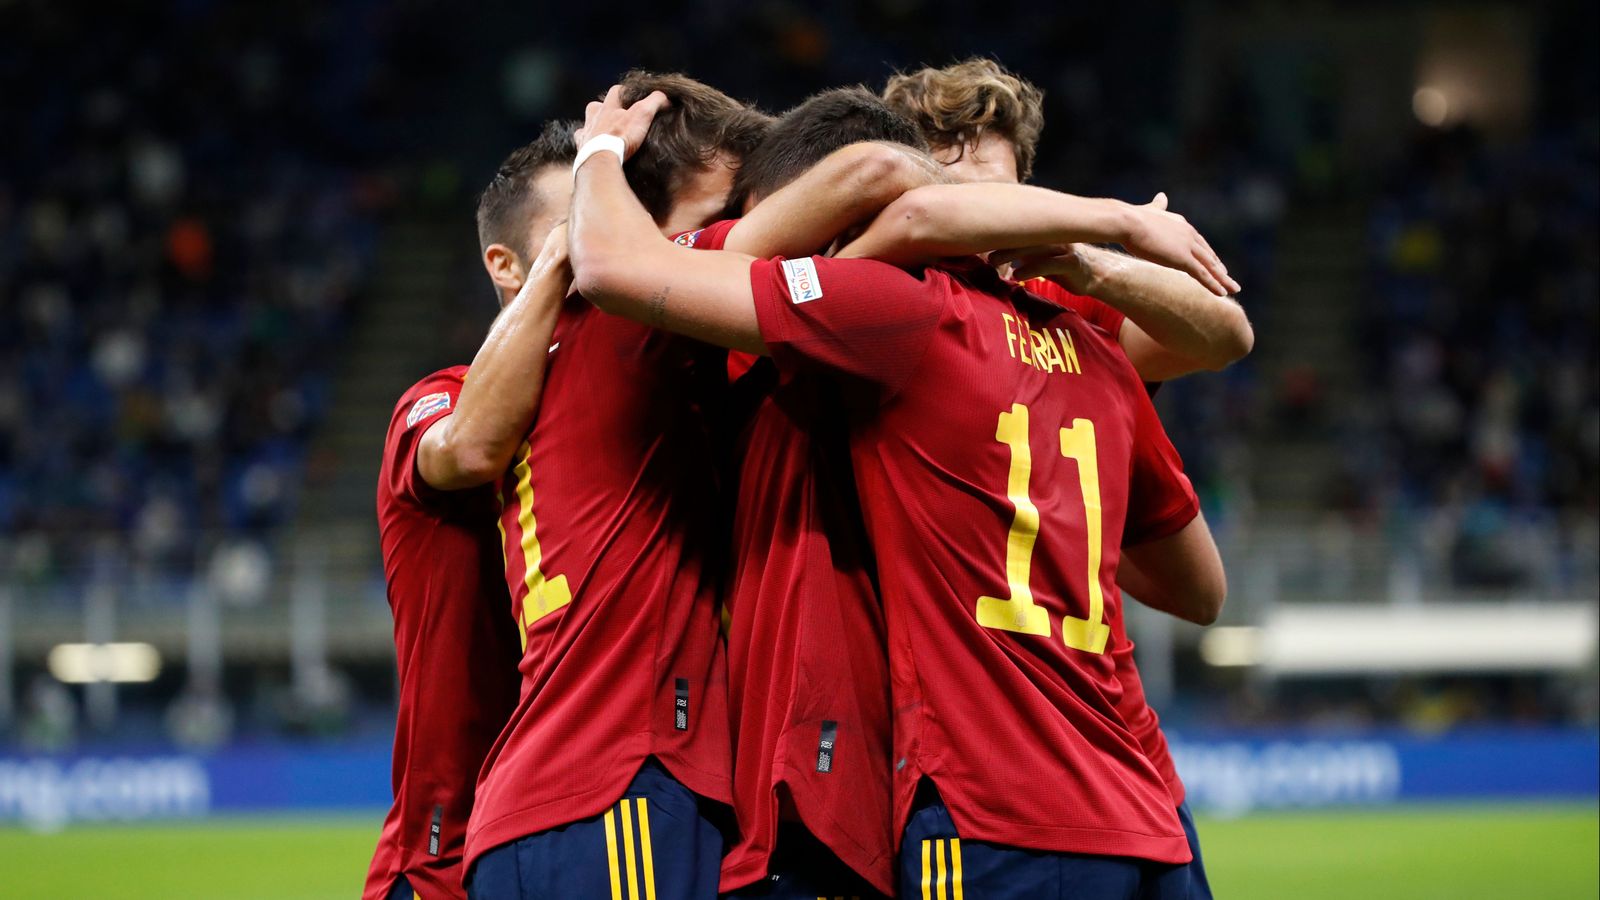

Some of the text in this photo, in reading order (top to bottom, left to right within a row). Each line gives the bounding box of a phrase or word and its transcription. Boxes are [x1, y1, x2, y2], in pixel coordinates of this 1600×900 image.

[795, 261, 814, 300] ATION
[497, 440, 572, 654] 1
[976, 403, 1110, 655] 11
